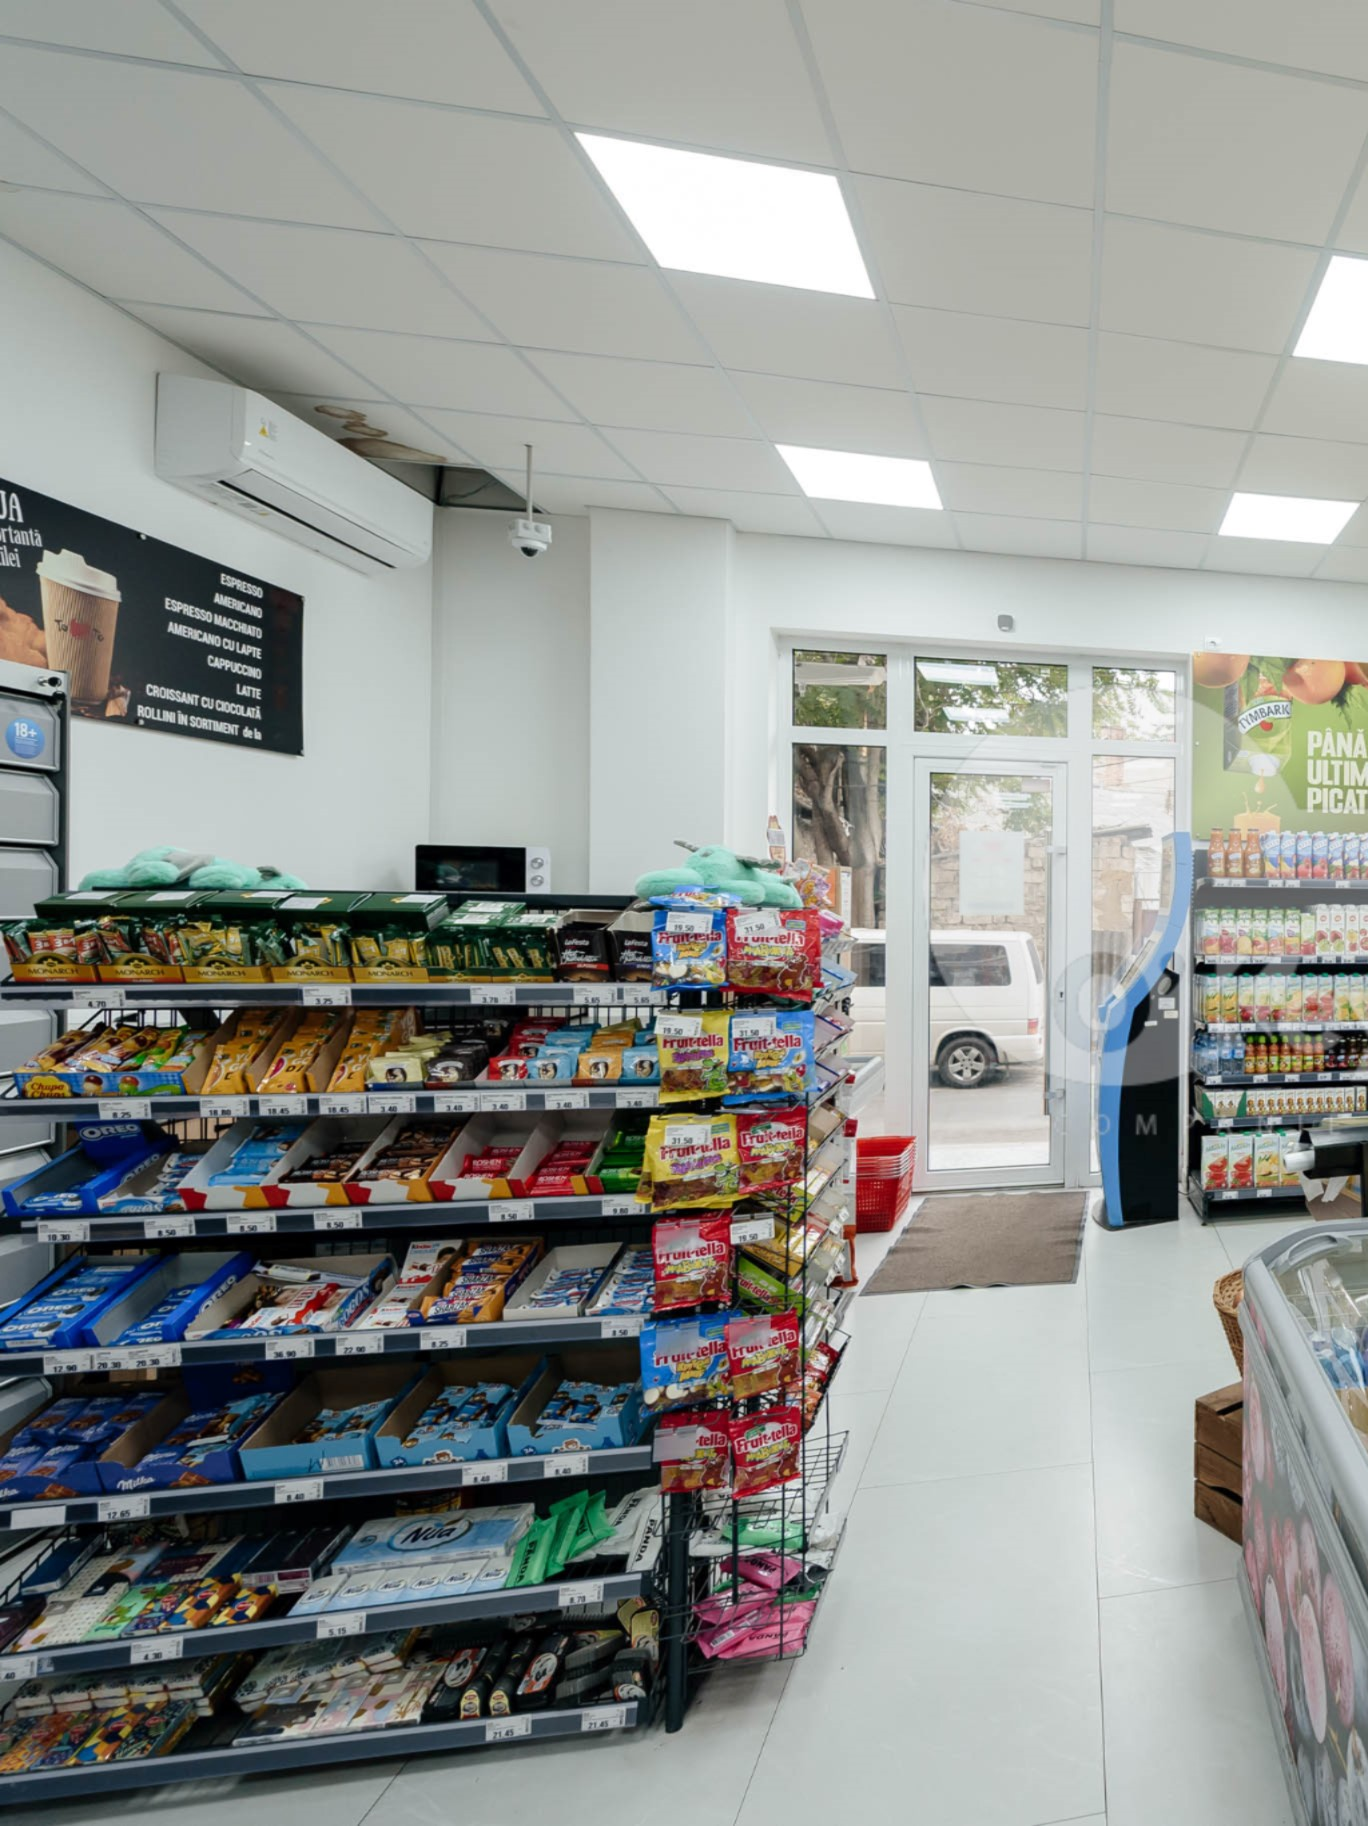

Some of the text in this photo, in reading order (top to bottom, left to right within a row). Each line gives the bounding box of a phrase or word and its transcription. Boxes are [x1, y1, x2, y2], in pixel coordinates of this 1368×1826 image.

[221, 573, 263, 599] ESPRESSO
[213, 593, 263, 619] AMERICANO
[165, 597, 262, 640] ESPRESSO MACCHIATO
[167, 621, 262, 660] AMERICANO CU LAPTE
[207, 655, 262, 680] CAPPUCCINO
[236, 683, 262, 700] LATTE
[146, 684, 262, 720] CROISSANT CU CIOCOLATĂ
[1238, 702, 1291, 730] TYMBARK
[137, 704, 176, 724] ROLLINI
[190, 714, 240, 737] SORTIMENT
[243, 726, 253, 738] de
[253, 727, 262, 740] la
[14, 721, 37, 739] 18+
[1307, 728, 1368, 759] PÂNĂ
[674, 924, 695, 932] 19.50
[27, 967, 79, 976] MONARCH
[115, 969, 165, 977] MONARCH
[197, 969, 246, 978] MONARCH
[286, 969, 334, 978] MONARCH
[368, 970, 414, 978] MONARCH
[315, 997, 333, 1005] 3.75
[663, 1027, 683, 1036] 19.50
[740, 1029, 759, 1037] 31.50
[733, 1034, 802, 1051] Fruit-tella
[30, 1082, 64, 1092] Chupa
[112, 1111, 131, 1119] 8.25
[268, 1107, 290, 1115] 18.45
[328, 1106, 349, 1114] 18.45
[79, 1122, 141, 1142] OREO
[740, 1126, 805, 1146] Fruit-tella
[672, 1137, 693, 1145] 31.50
[472, 1159, 502, 1169] ROSHEN
[538, 1175, 568, 1184] ROSHEN
[52, 1287, 96, 1297] OREO
[201, 1275, 238, 1313] OREO
[27, 1304, 72, 1315] OREO
[1, 1321, 49, 1333] OREO
[734, 1423, 798, 1454] Fruit-tella
[117, 1476, 156, 1491] Milka
[107, 1510, 131, 1519] 12.65
[635, 1519, 658, 1562] PANDA
[517, 1540, 538, 1583] PANDA
[329, 1627, 346, 1635] 5.15
